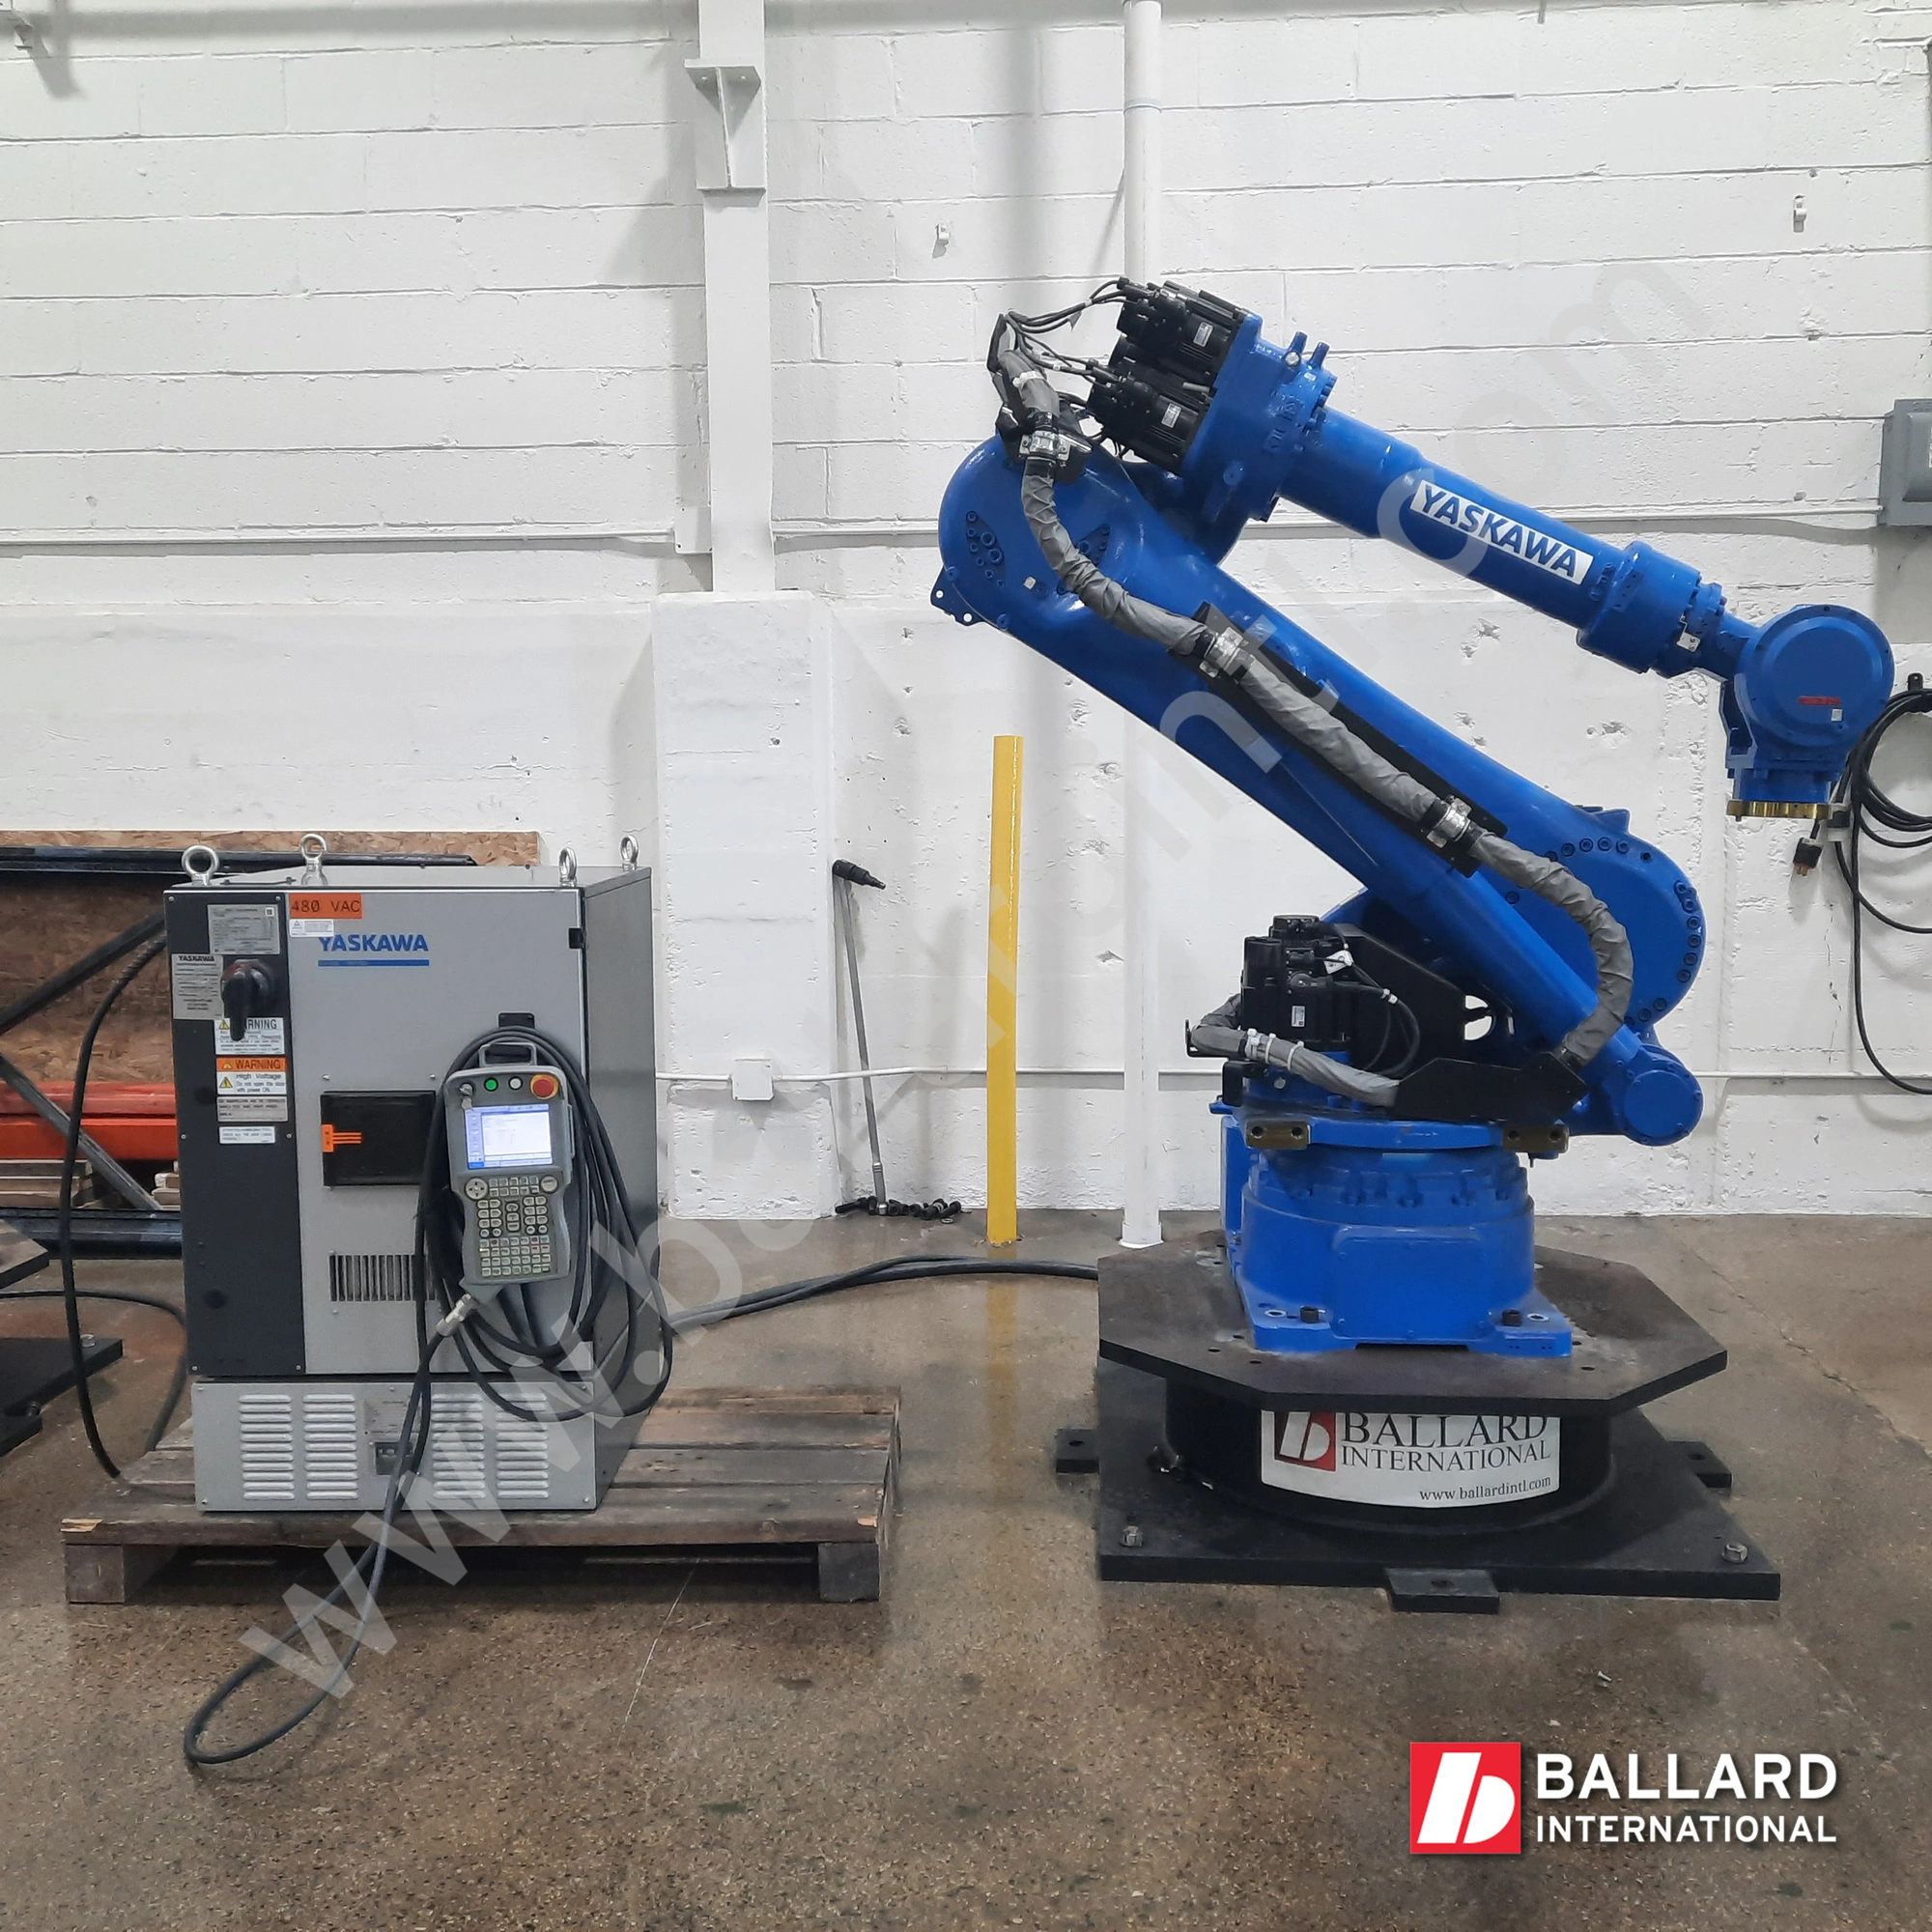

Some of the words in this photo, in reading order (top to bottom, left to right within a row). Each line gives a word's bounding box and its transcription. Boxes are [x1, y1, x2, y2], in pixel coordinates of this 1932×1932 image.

[1422, 484, 1577, 579] YASKAWA
[291, 899, 320, 913] 480
[330, 899, 362, 913] VAC
[318, 934, 429, 952] YASKAWA
[247, 1018, 277, 1031] RNING
[235, 1059, 281, 1069] WARNING
[1342, 1412, 1548, 1448] BALLARD
[1341, 1439, 1551, 1472] INTERNATIONAL
[1419, 1476, 1551, 1501] www.ballardintl.com
